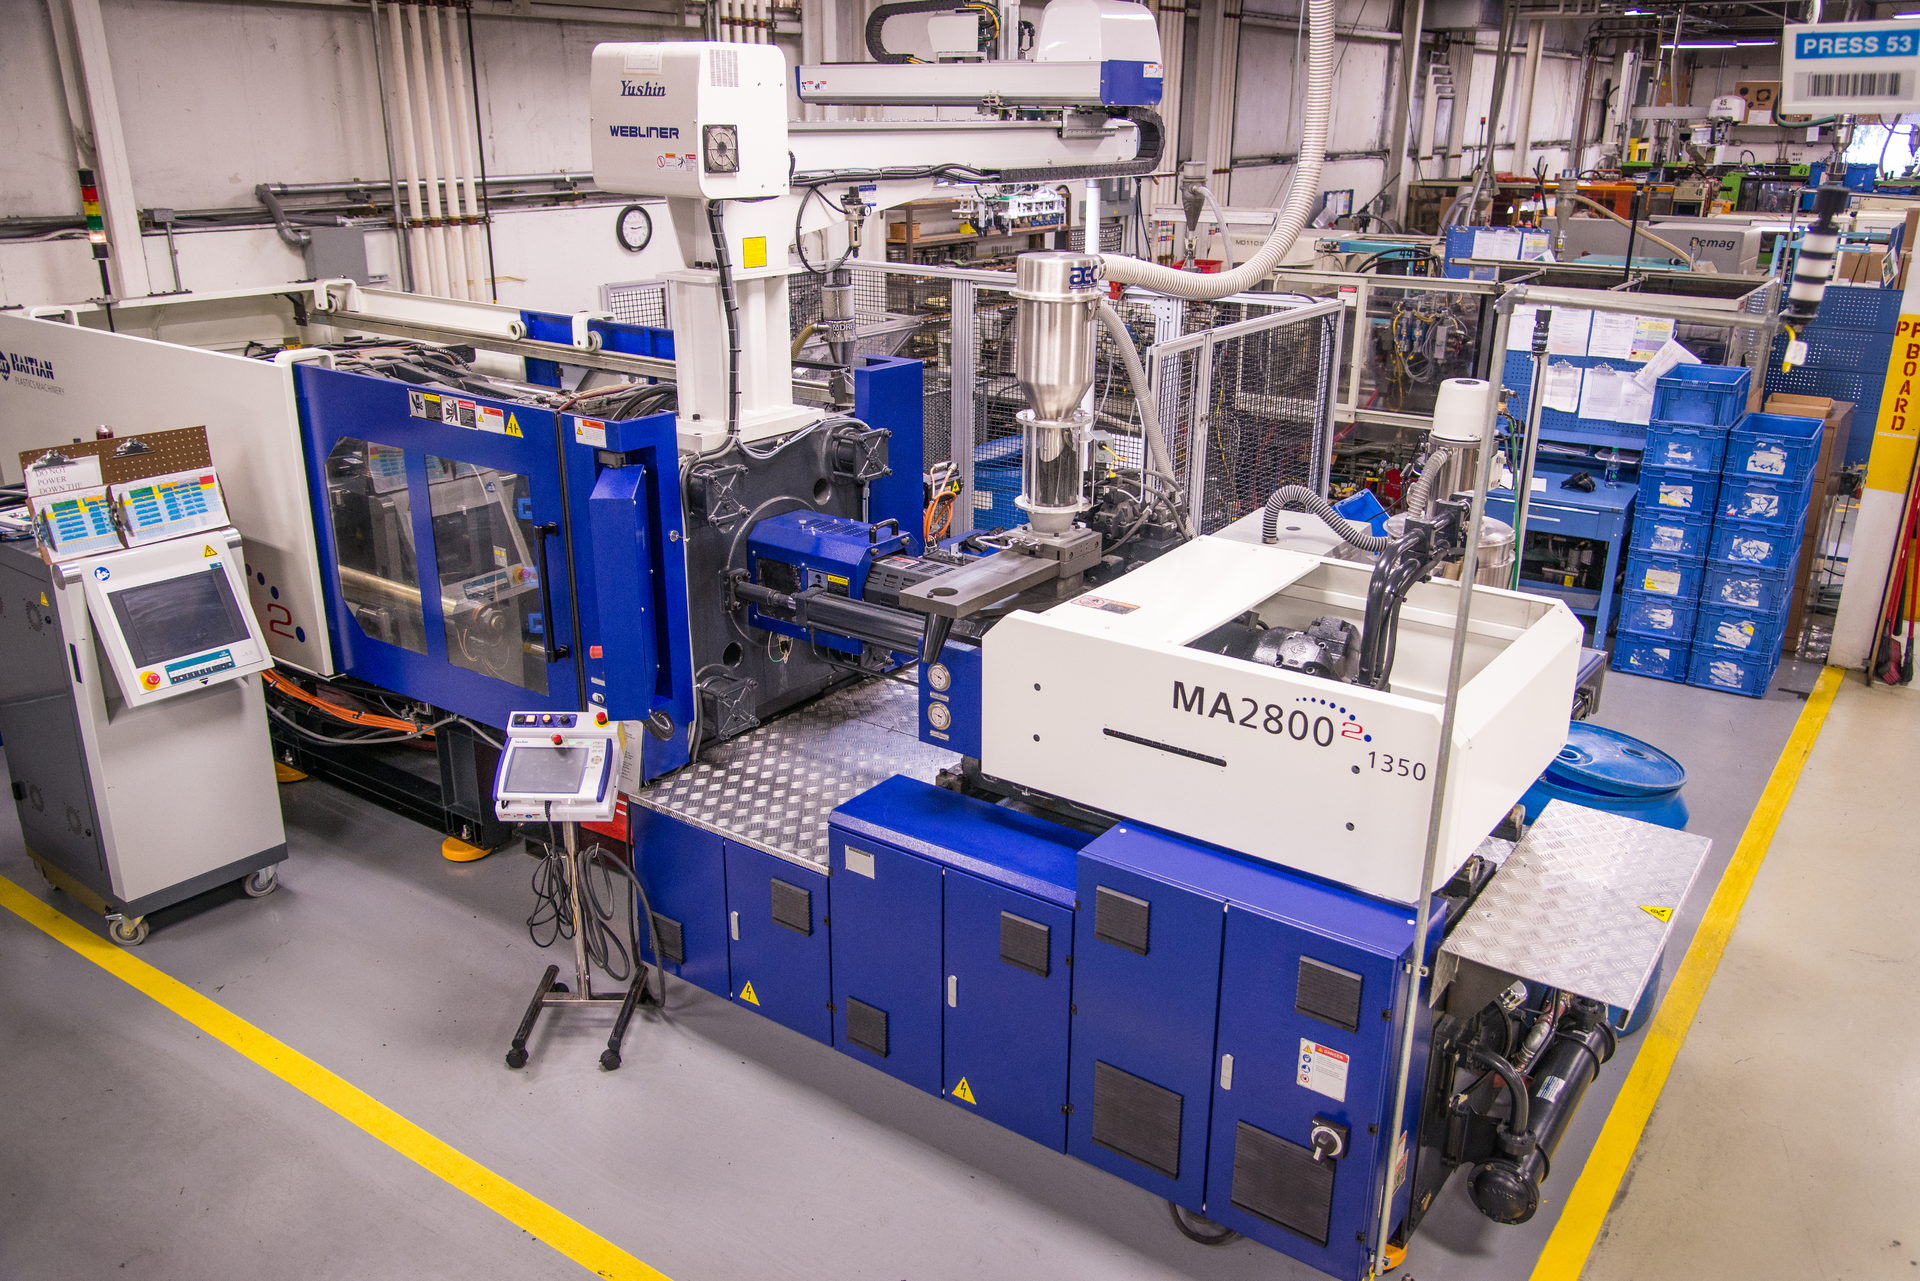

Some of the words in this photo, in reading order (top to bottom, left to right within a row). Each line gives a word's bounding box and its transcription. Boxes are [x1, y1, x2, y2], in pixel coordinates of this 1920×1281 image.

[1803, 36, 1879, 54] PRESS
[1886, 35, 1912, 53] 53
[620, 80, 666, 97] Yushin
[609, 125, 679, 139] WEBLINER
[1689, 236, 1735, 251] Demag
[1399, 250, 1412, 259] 44
[10, 352, 54, 380] HAITIAN
[35, 468, 48, 477] DO
[49, 465, 66, 475] NOT
[37, 475, 66, 486] POWER
[39, 485, 65, 495] DOWN
[67, 482, 83, 490] THE
[267, 603, 295, 640] 2
[1172, 680, 1334, 747] MA2800
[1341, 721, 1364, 741] 2
[1367, 751, 1427, 781] 1350
[1323, 1049, 1344, 1060] DANGER
